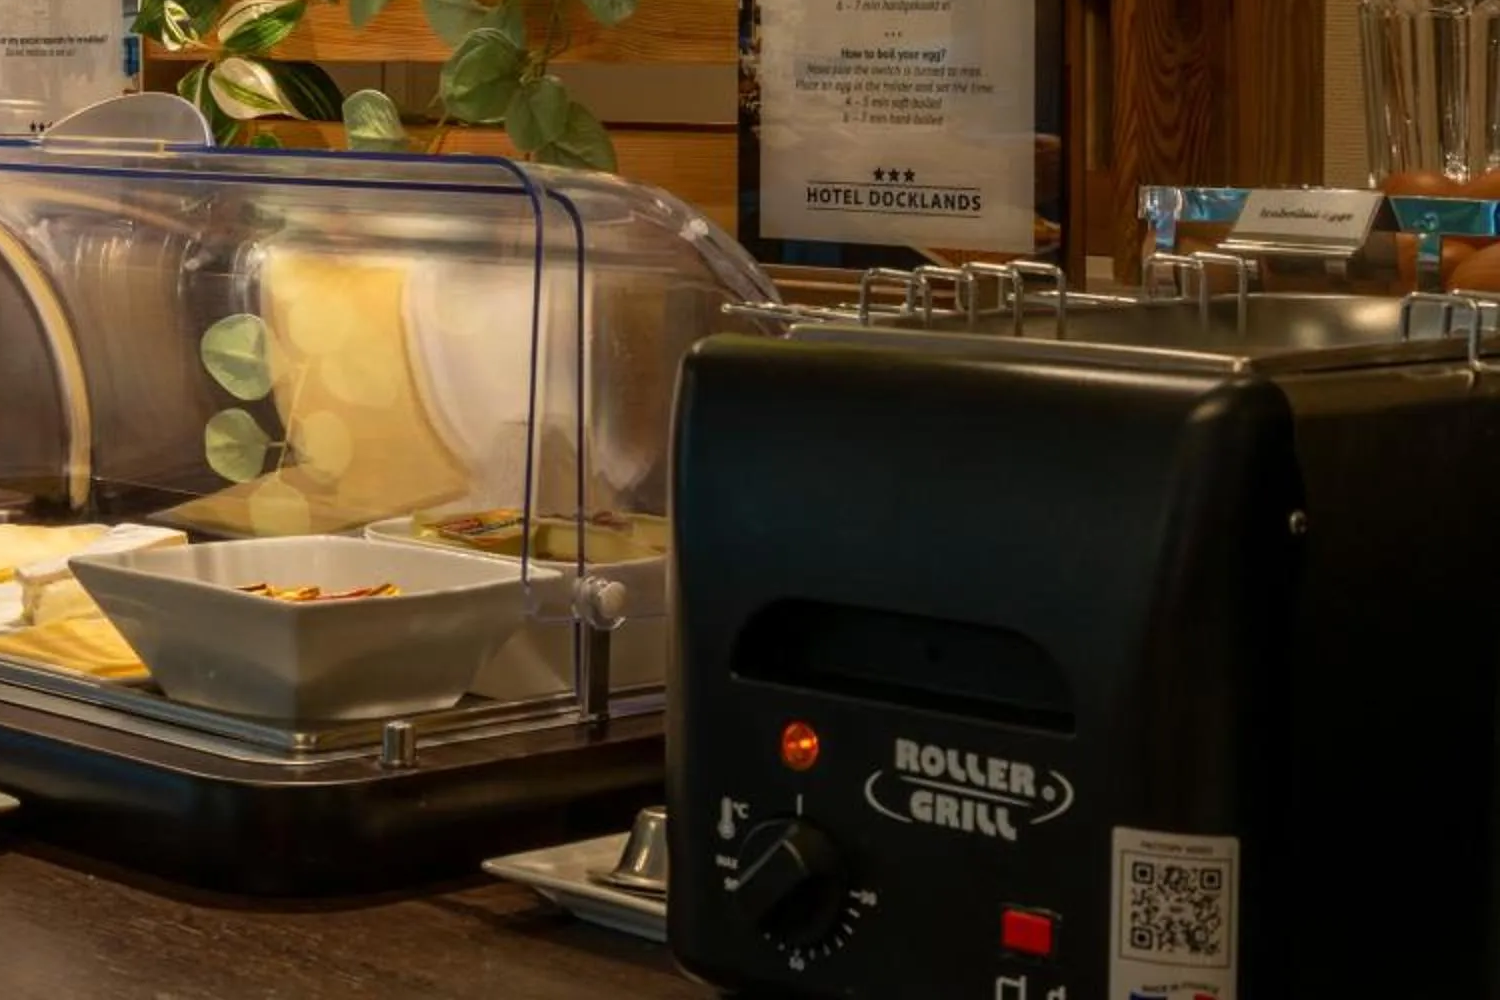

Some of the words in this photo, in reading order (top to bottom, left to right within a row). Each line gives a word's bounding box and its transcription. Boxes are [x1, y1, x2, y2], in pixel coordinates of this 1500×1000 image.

[864, 49, 875, 59] to
[806, 187, 864, 205] HOTEL
[869, 190, 982, 211] DOCKLANDS
[895, 737, 1036, 798] ROLLER
[909, 789, 1018, 842] GRILL
